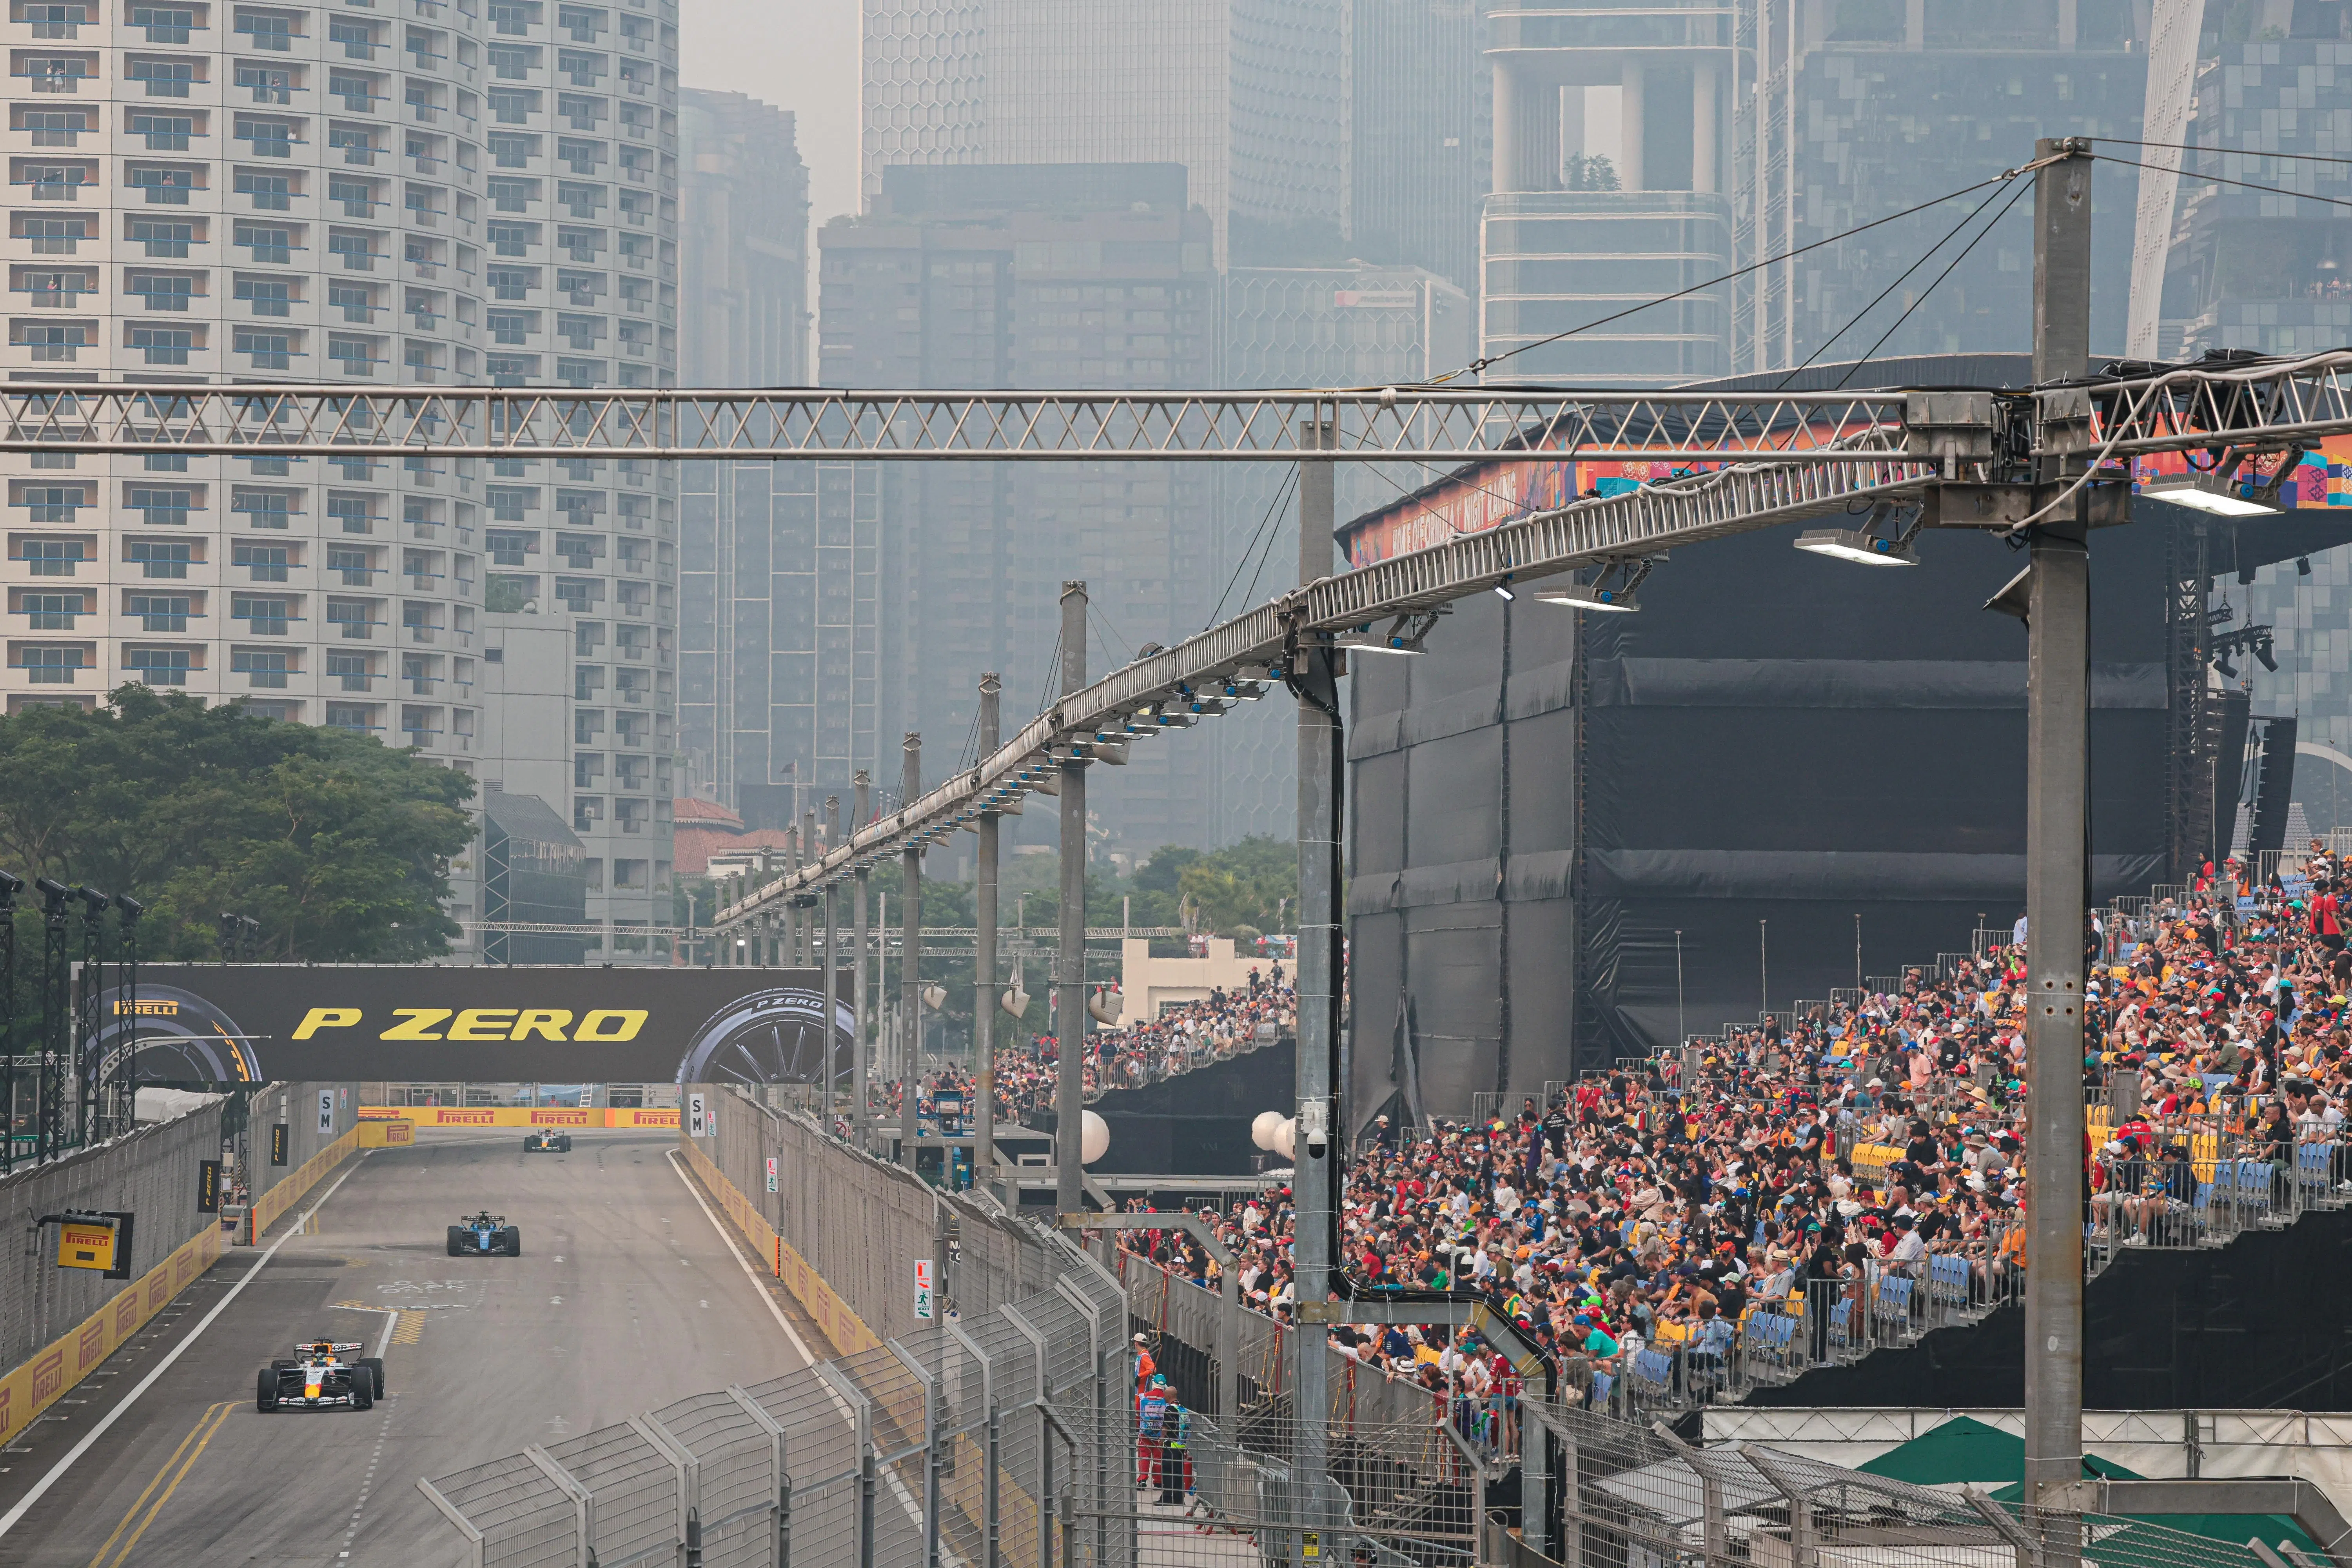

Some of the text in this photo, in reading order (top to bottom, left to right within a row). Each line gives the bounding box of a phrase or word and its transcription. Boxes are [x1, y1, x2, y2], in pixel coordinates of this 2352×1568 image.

[113, 1000, 179, 1015] PIRELLI
[757, 998, 823, 1009] P ZERO
[291, 1008, 649, 1042] P ZERO
[322, 1096, 331, 1109] S
[693, 1100, 701, 1112] S
[321, 1114, 330, 1128] M
[437, 1110, 495, 1123] PIRELLI
[531, 1111, 587, 1124] PIRELLI
[693, 1118, 701, 1131] M
[386, 1125, 409, 1142] PIRELLI
[66, 1232, 109, 1247] PIRELLI
[116, 1291, 137, 1339] PIRELLI
[78, 1319, 103, 1371] PIRELLI
[32, 1349, 63, 1409] PIRELLI
